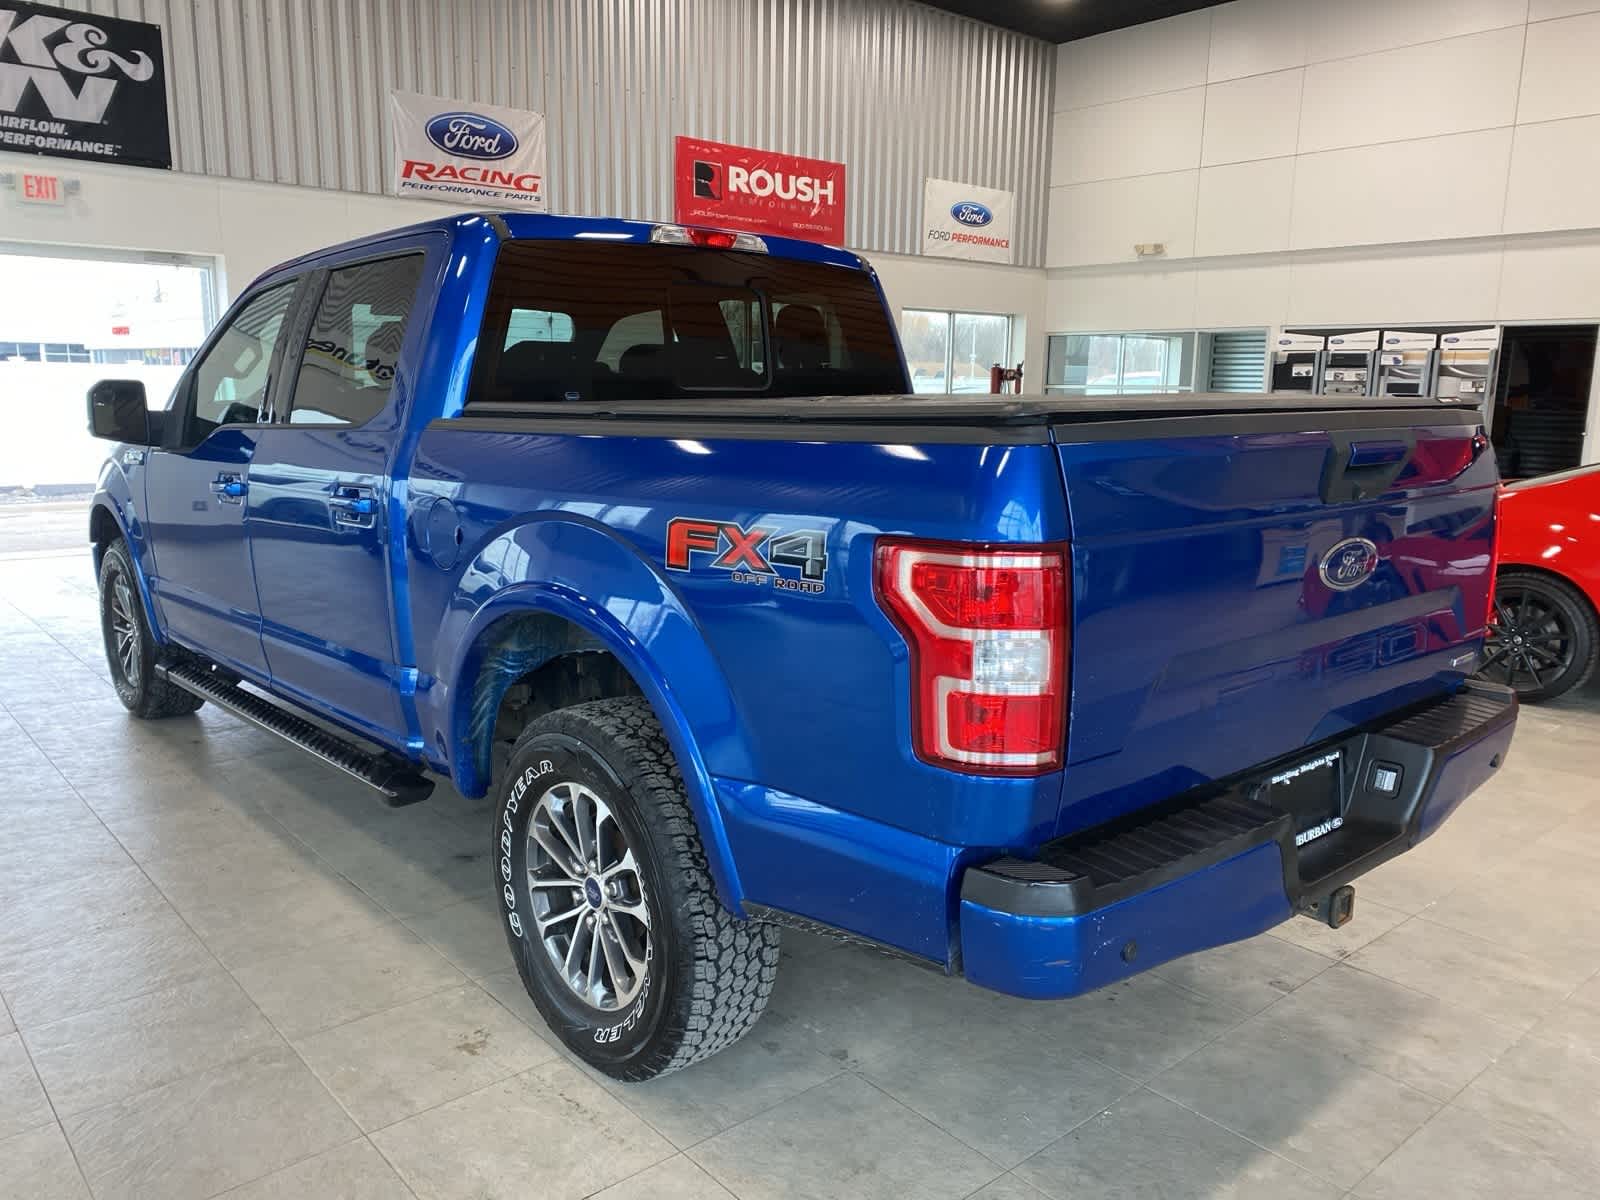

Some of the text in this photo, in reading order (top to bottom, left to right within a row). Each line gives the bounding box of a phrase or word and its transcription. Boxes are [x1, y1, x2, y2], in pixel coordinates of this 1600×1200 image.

[0, 115, 69, 136] IRFLOW.
[444, 118, 502, 155] Ford
[23, 174, 57, 200] EXIT
[402, 160, 542, 193] RACING
[728, 165, 835, 206] ROUSH
[402, 181, 542, 203] PERFORMANCE PARTS
[959, 205, 985, 223] Ford
[928, 230, 1009, 249] FORD PERFORMANCE
[665, 516, 829, 583] FX4
[731, 571, 825, 594] OFF ROAD
[1295, 821, 1332, 847] BURBAN
[501, 760, 554, 938] GOODYEAR
